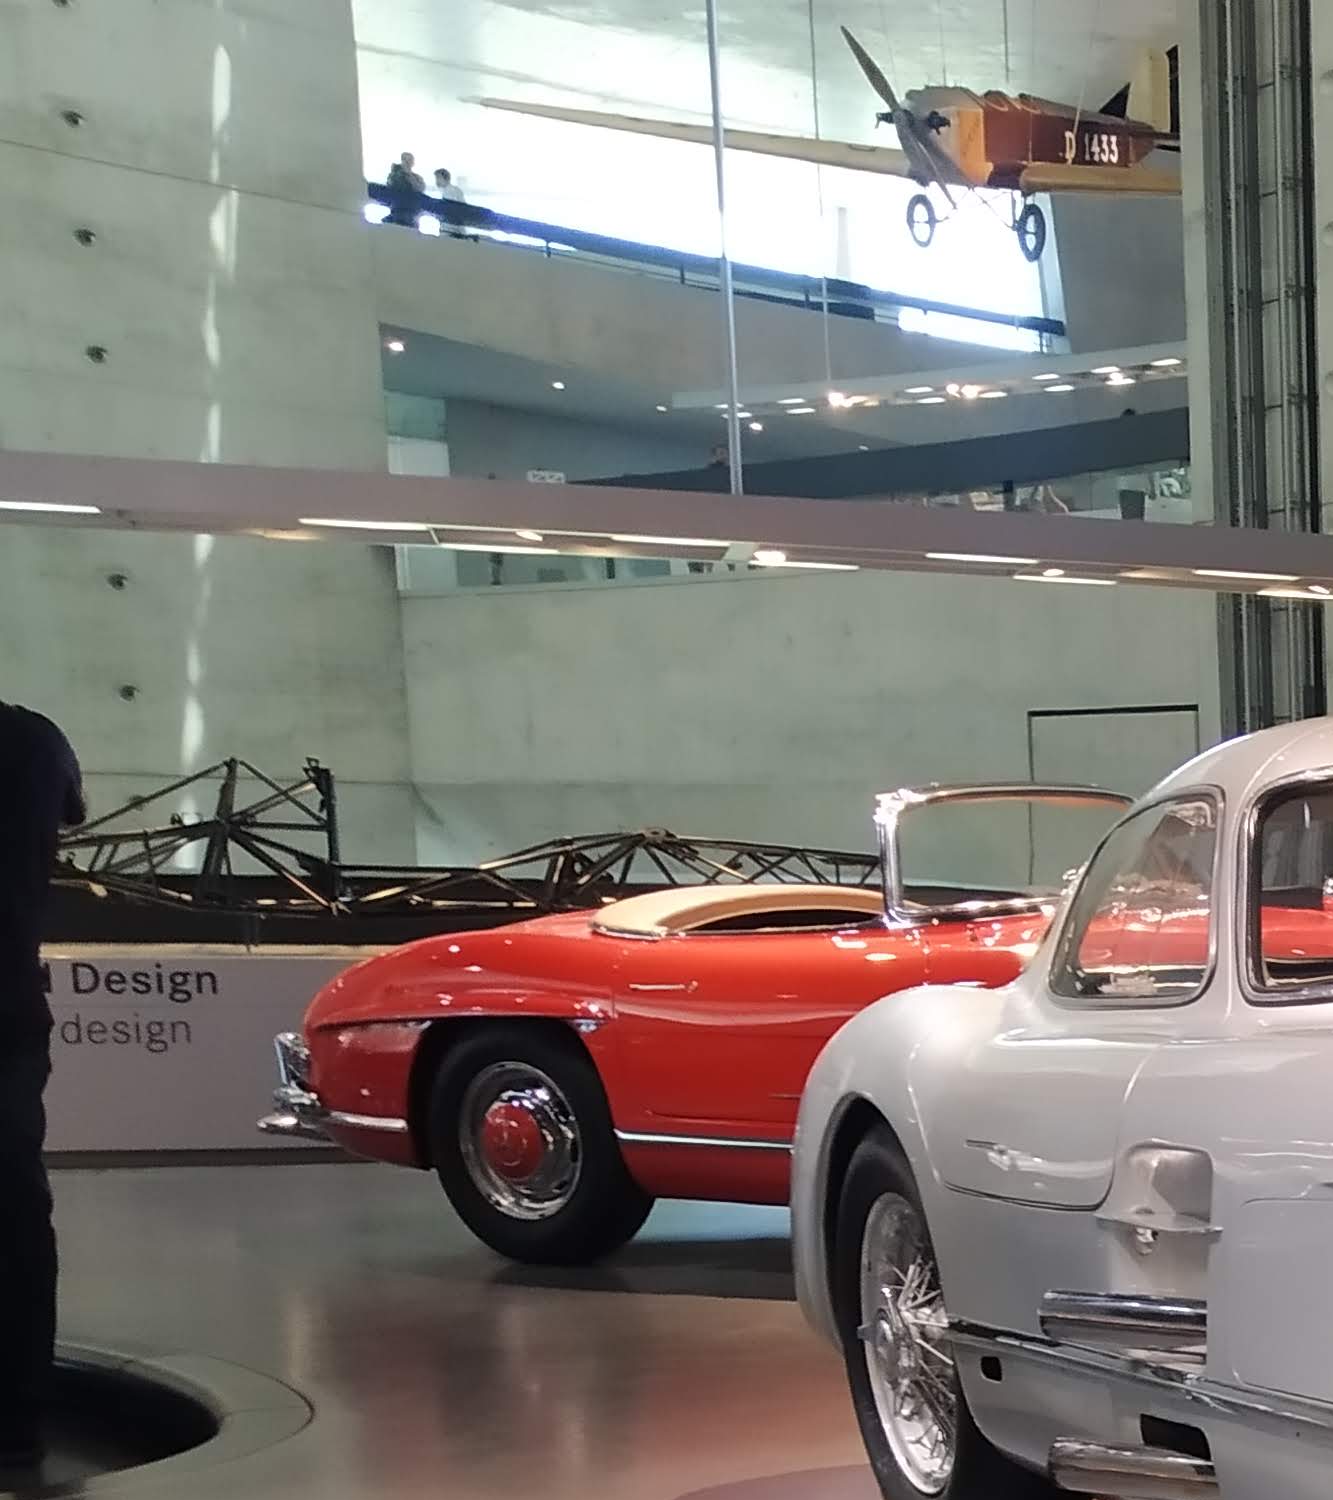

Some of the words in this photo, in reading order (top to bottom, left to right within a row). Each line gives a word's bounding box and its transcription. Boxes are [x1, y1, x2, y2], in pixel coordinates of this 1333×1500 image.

[1065, 131, 1076, 160] D
[1084, 133, 1119, 164] 1433
[72, 962, 218, 1003] Design
[61, 1012, 192, 1053] design
